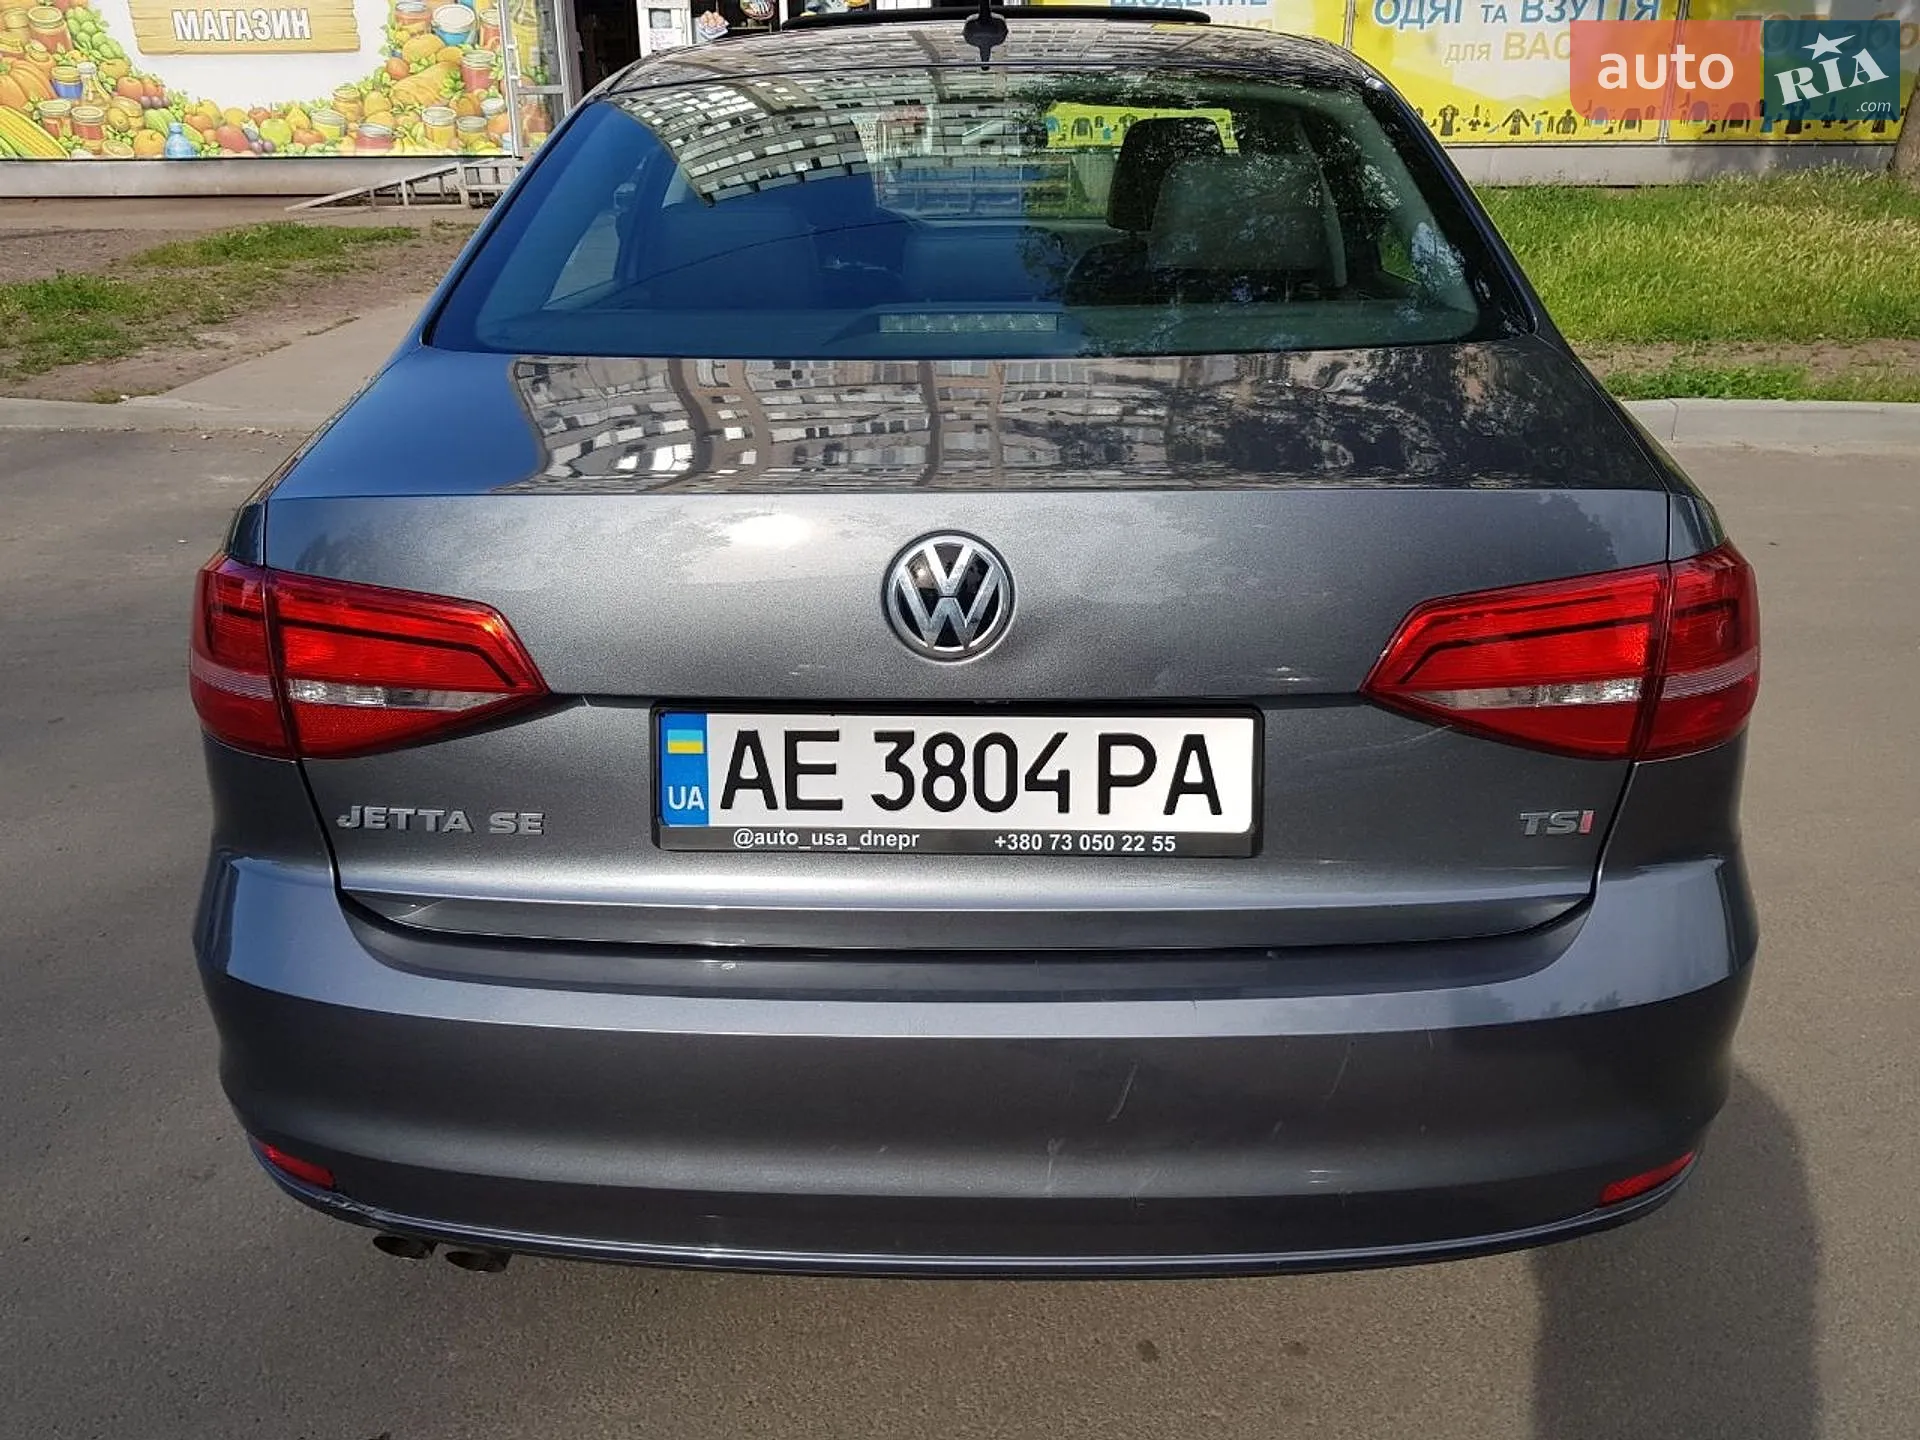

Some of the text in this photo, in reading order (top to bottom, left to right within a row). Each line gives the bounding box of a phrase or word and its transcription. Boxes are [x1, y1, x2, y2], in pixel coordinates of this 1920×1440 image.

[172, 8, 312, 41] МАГАЗИН
[720, 730, 1223, 815] AE 3804 PA
[667, 786, 705, 811] UA
[336, 805, 545, 835] JETTA SE
[1520, 810, 1595, 835] TSI
[733, 828, 920, 850] @auto_usa_dnepr
[994, 834, 1177, 852] +380 73 050 22 55
